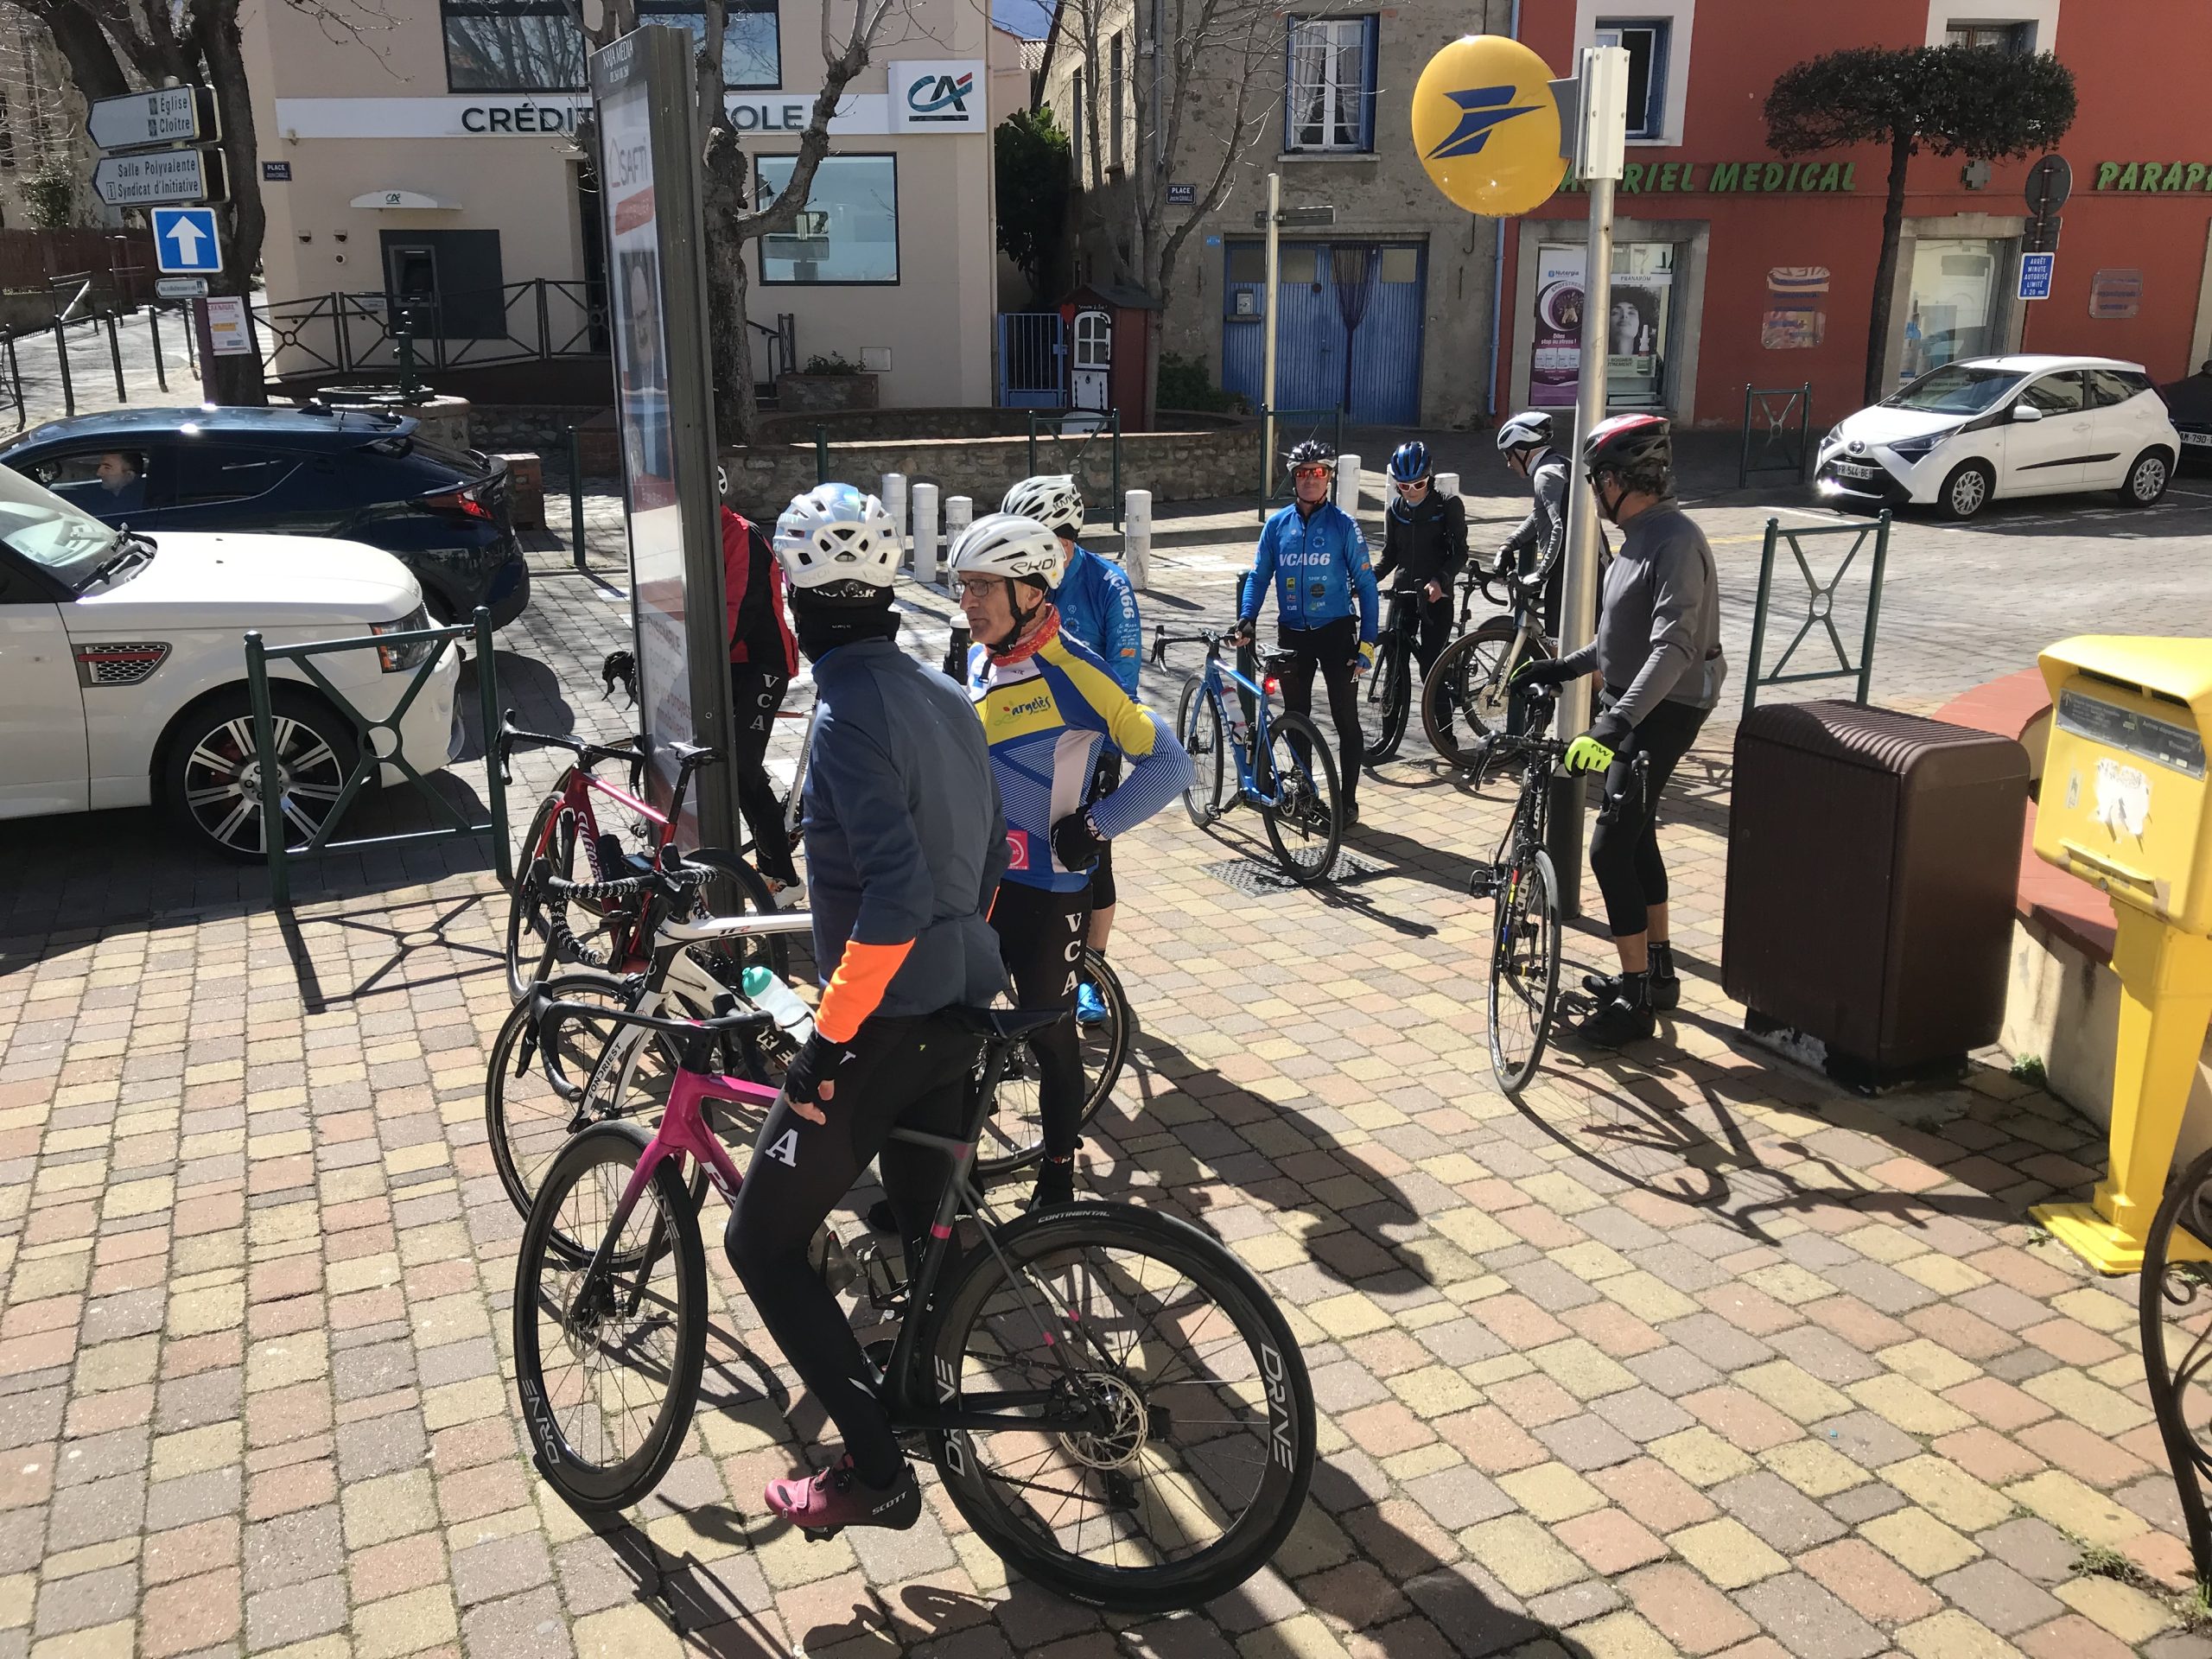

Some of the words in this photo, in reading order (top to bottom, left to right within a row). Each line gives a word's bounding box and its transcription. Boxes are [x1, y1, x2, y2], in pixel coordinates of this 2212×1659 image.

[160, 94, 188, 115] Église
[118, 163, 139, 178] Salle
[144, 158, 195, 176] Polyvalente
[1709, 162, 1857, 193] MEDICAL
[2097, 162, 2212, 194] PARAP
[118, 181, 151, 200] Syndicat
[154, 178, 199, 194] d'Initiative
[1279, 552, 1331, 567] VCA66
[588, 1042, 621, 1100] FONDRIEST
[1260, 1342, 1294, 1474] DRIVE
[872, 1491, 907, 1516] SCOTT
